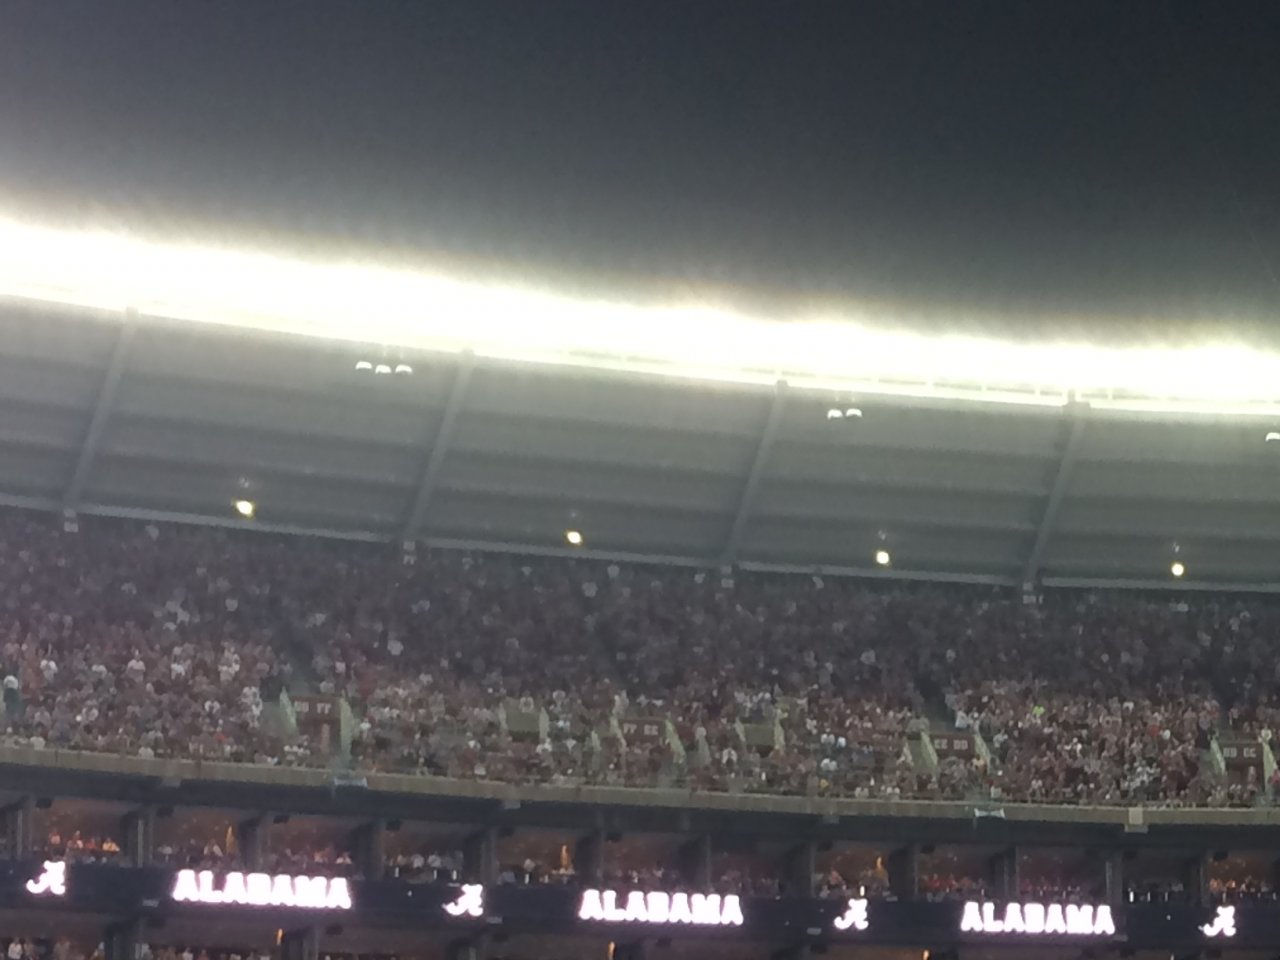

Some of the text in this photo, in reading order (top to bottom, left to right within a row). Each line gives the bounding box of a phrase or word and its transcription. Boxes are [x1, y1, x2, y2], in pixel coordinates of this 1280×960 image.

[172, 869, 352, 909] ALABAMA
[579, 889, 743, 925] ALABAMA
[961, 902, 1115, 934] ALABAMA
